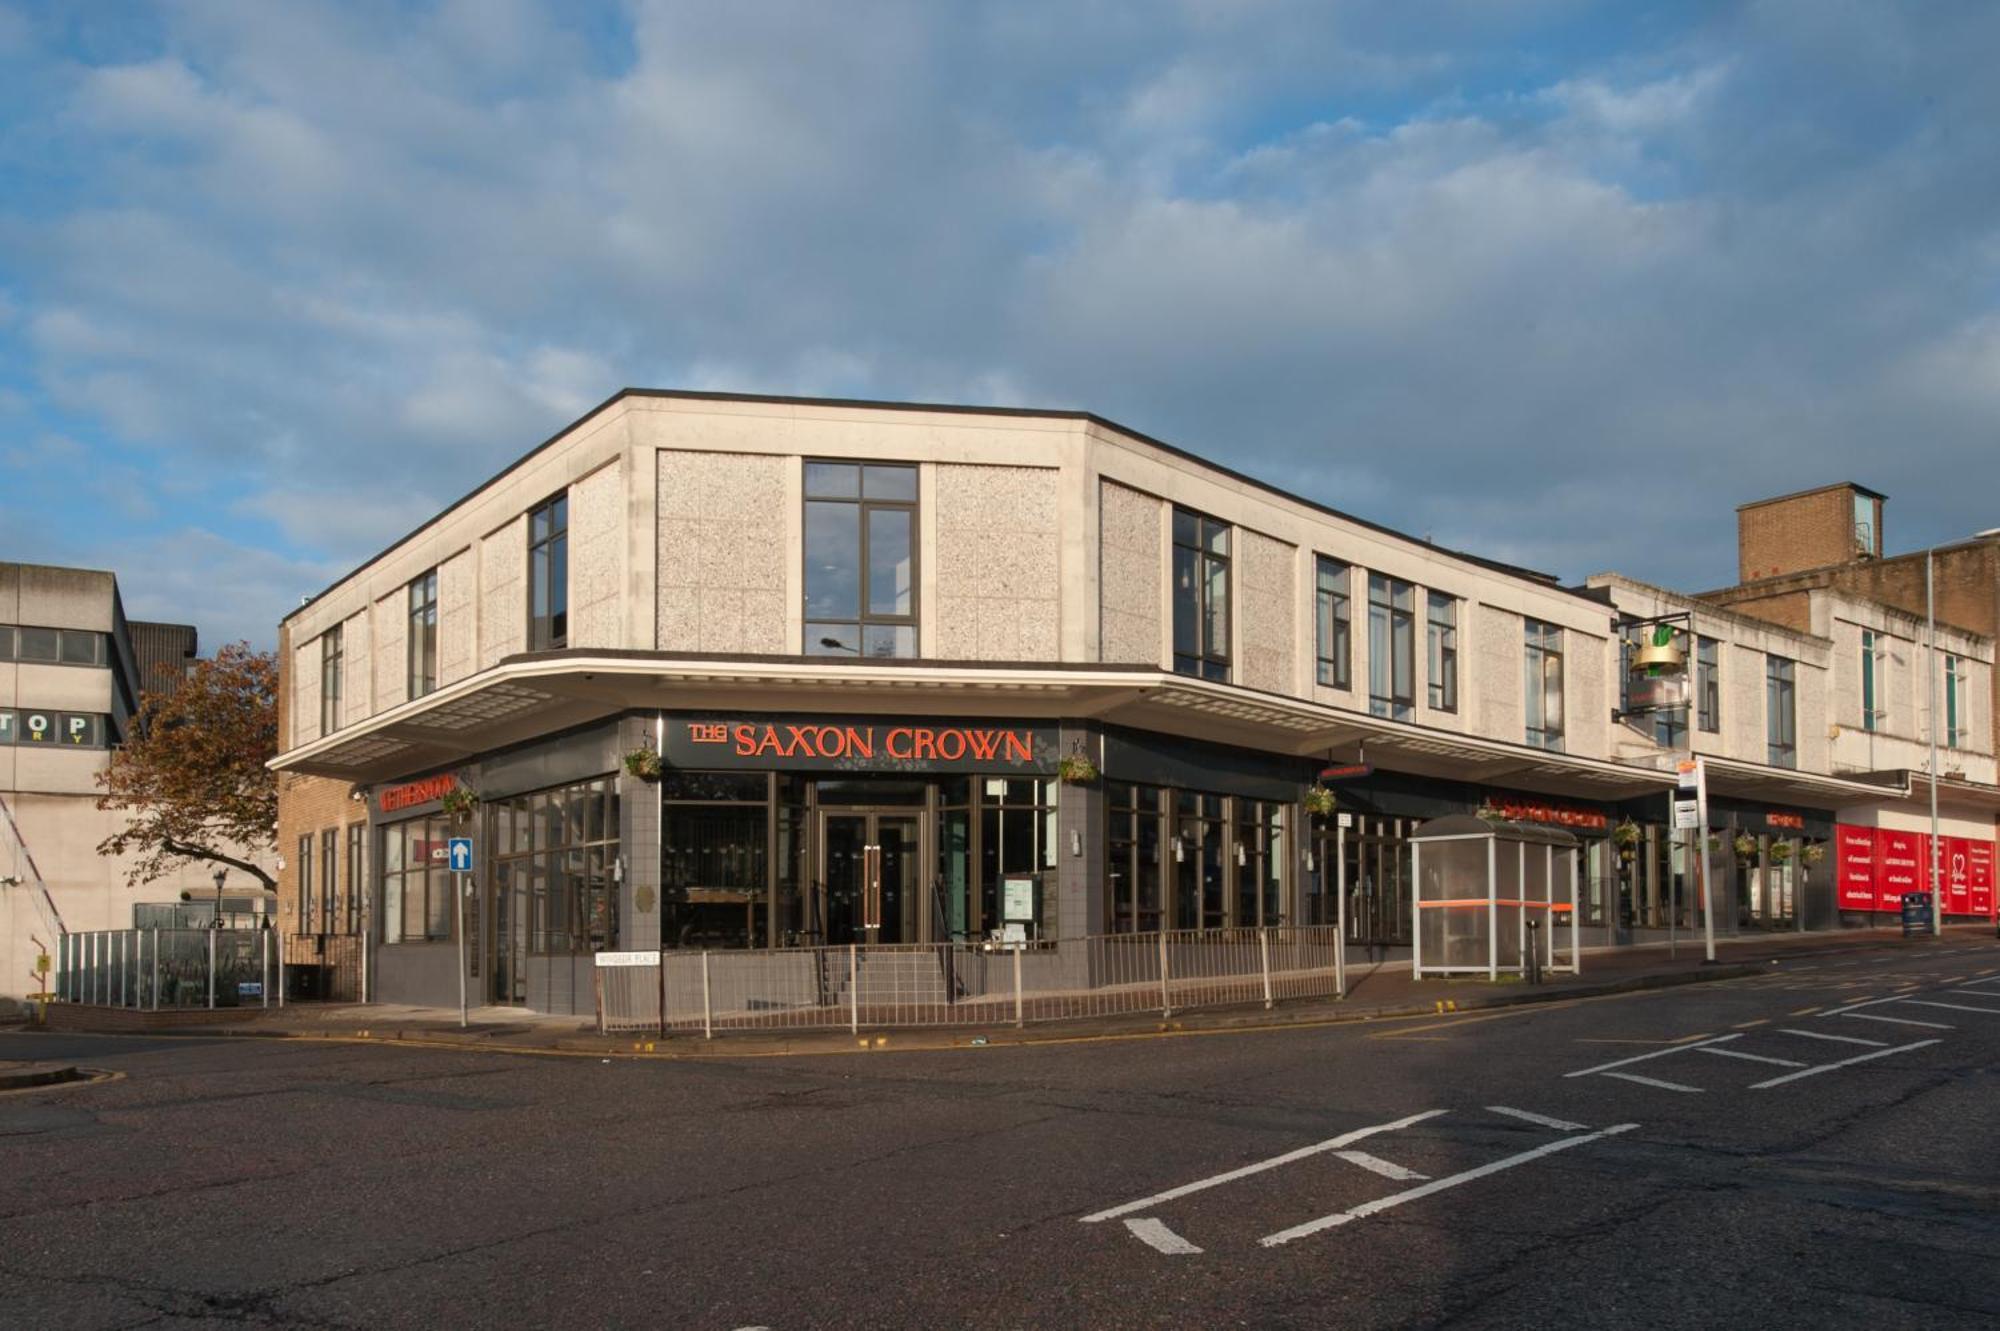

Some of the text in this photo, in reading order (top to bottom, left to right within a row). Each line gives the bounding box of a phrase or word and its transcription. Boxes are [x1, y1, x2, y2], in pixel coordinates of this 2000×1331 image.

[687, 724, 1033, 761] THE SAXON CROWN
